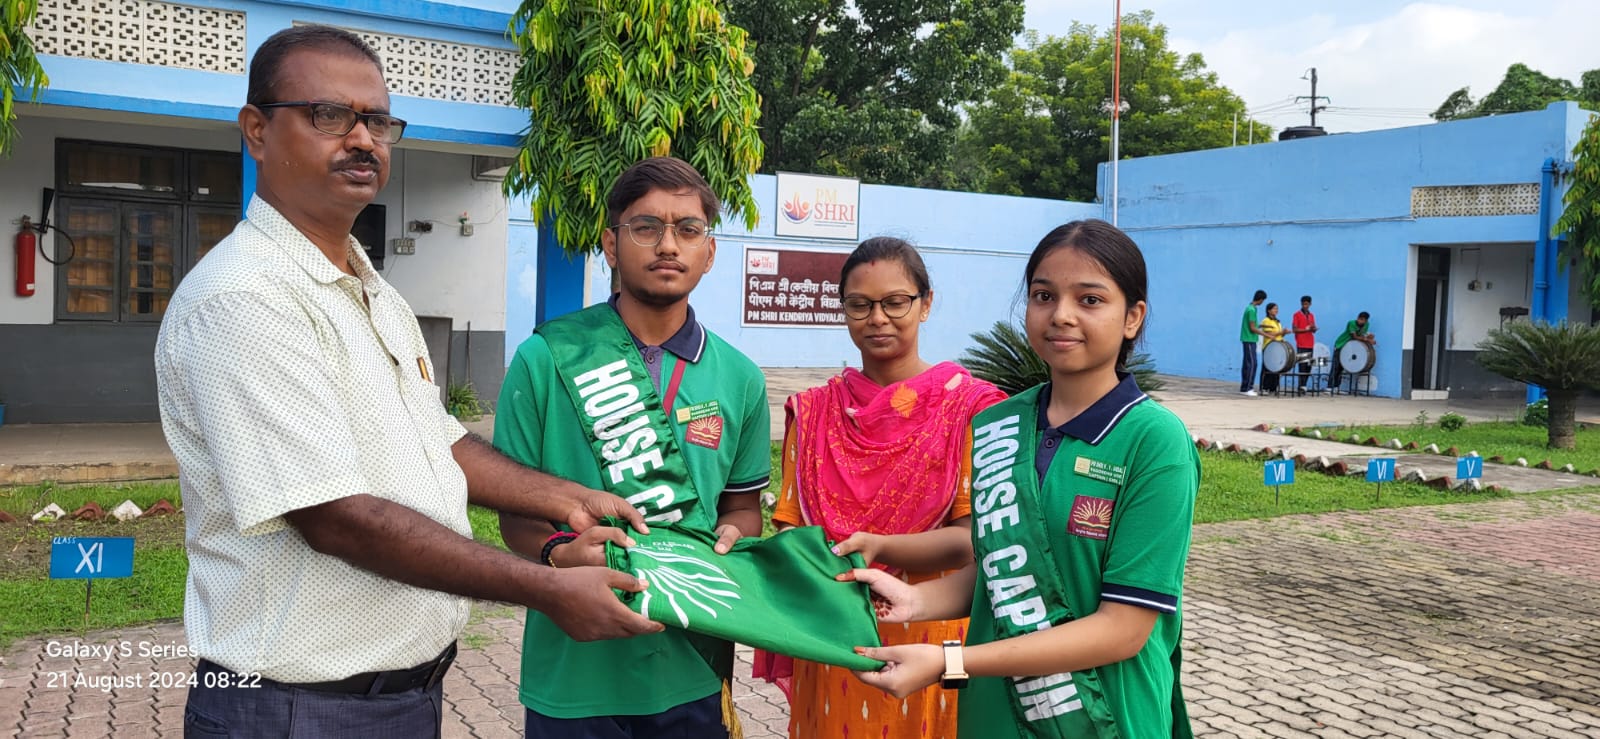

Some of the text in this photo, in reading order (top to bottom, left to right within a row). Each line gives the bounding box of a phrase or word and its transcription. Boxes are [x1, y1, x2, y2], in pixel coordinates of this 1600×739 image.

[815, 188, 837, 203] PM
[814, 203, 856, 222] SHRI
[775, 293, 787, 307] श्री
[747, 311, 760, 321] PM
[761, 311, 778, 321] SHRI
[780, 312, 813, 322] KENDRIYA
[573, 359, 665, 485] HOUSE
[1376, 461, 1387, 479] VI
[1466, 459, 1476, 477] V
[53, 536, 77, 545] CLASS
[75, 542, 103, 574] XI
[973, 414, 1083, 722] HOUSE CAPIN
